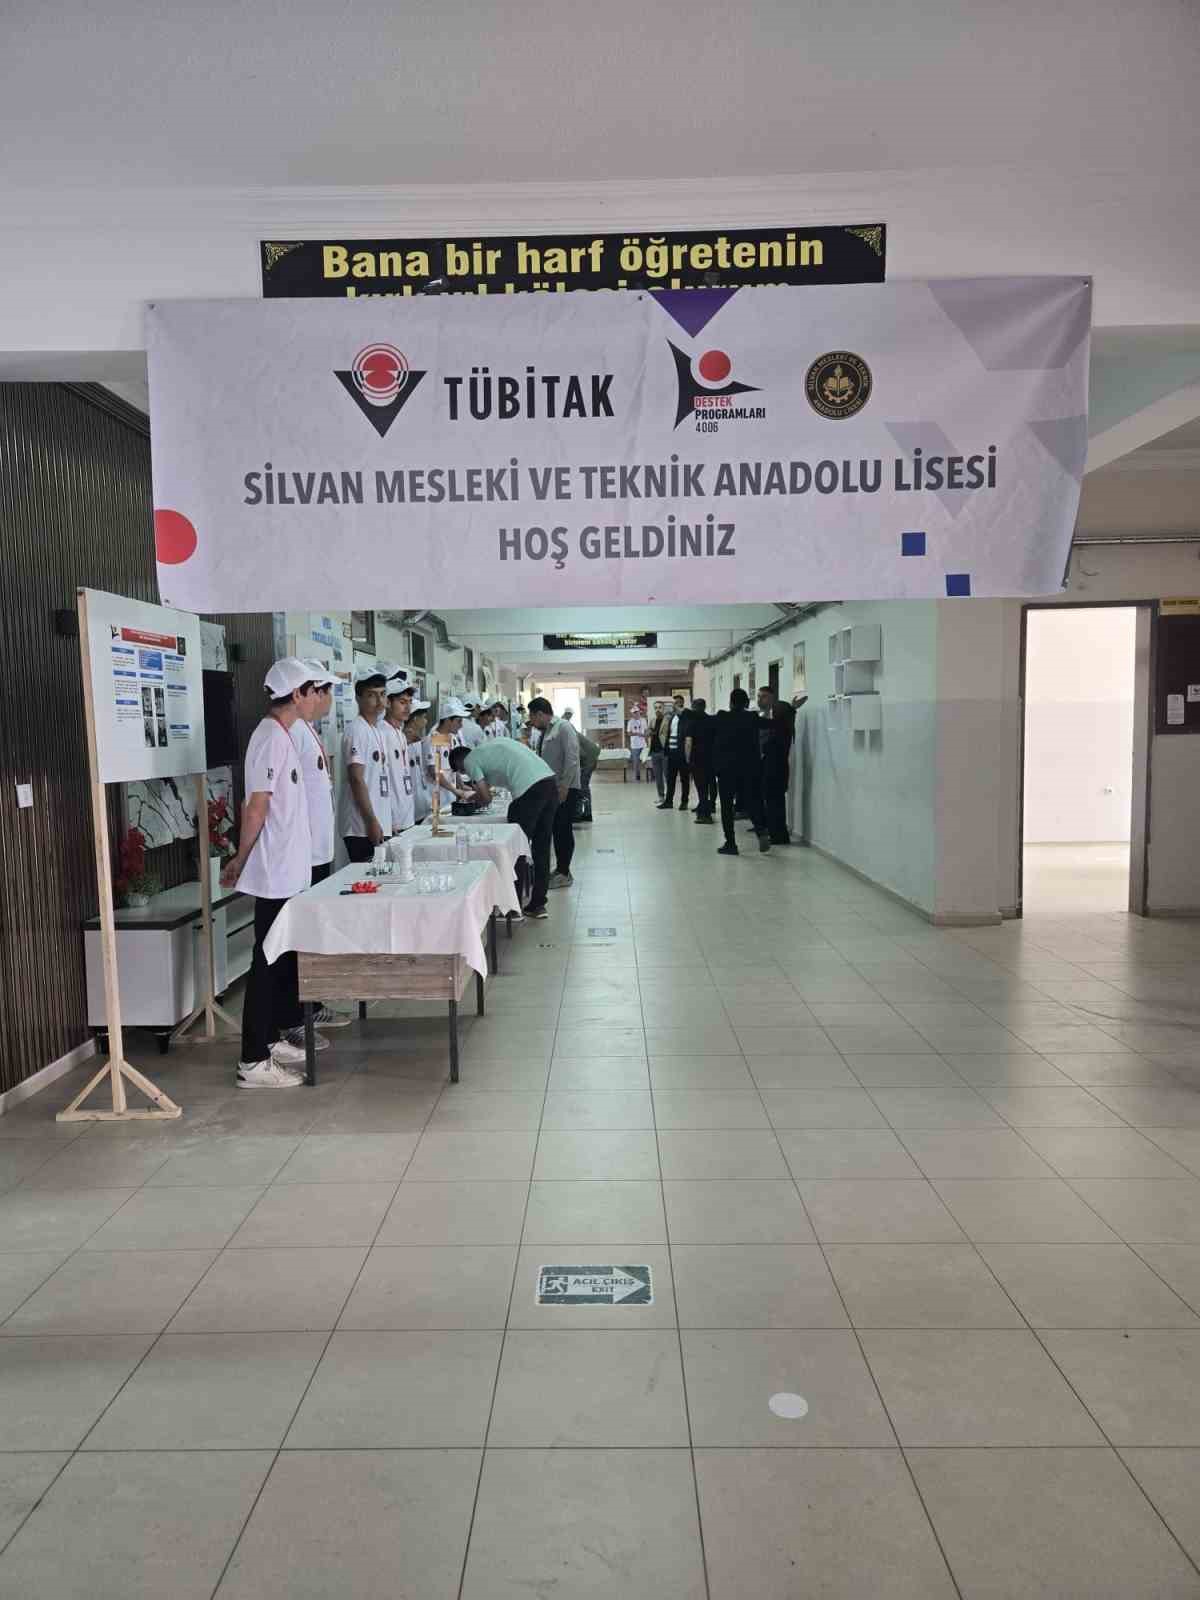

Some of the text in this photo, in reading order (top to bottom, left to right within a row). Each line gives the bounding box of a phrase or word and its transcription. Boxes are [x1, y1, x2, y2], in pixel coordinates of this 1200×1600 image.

[323, 233, 824, 278] Bana bir harf öğretenin
[443, 366, 615, 420] TÜBİTAK
[695, 396, 733, 408] DESTEK
[695, 407, 766, 420] PROGRAMLARI
[696, 421, 719, 433] 4006
[243, 445, 997, 505] SİLVAN MESLEKİ VE TEKNİK ANADOLU LİSESİ
[499, 514, 736, 570] HOŞ GELDİNİZ
